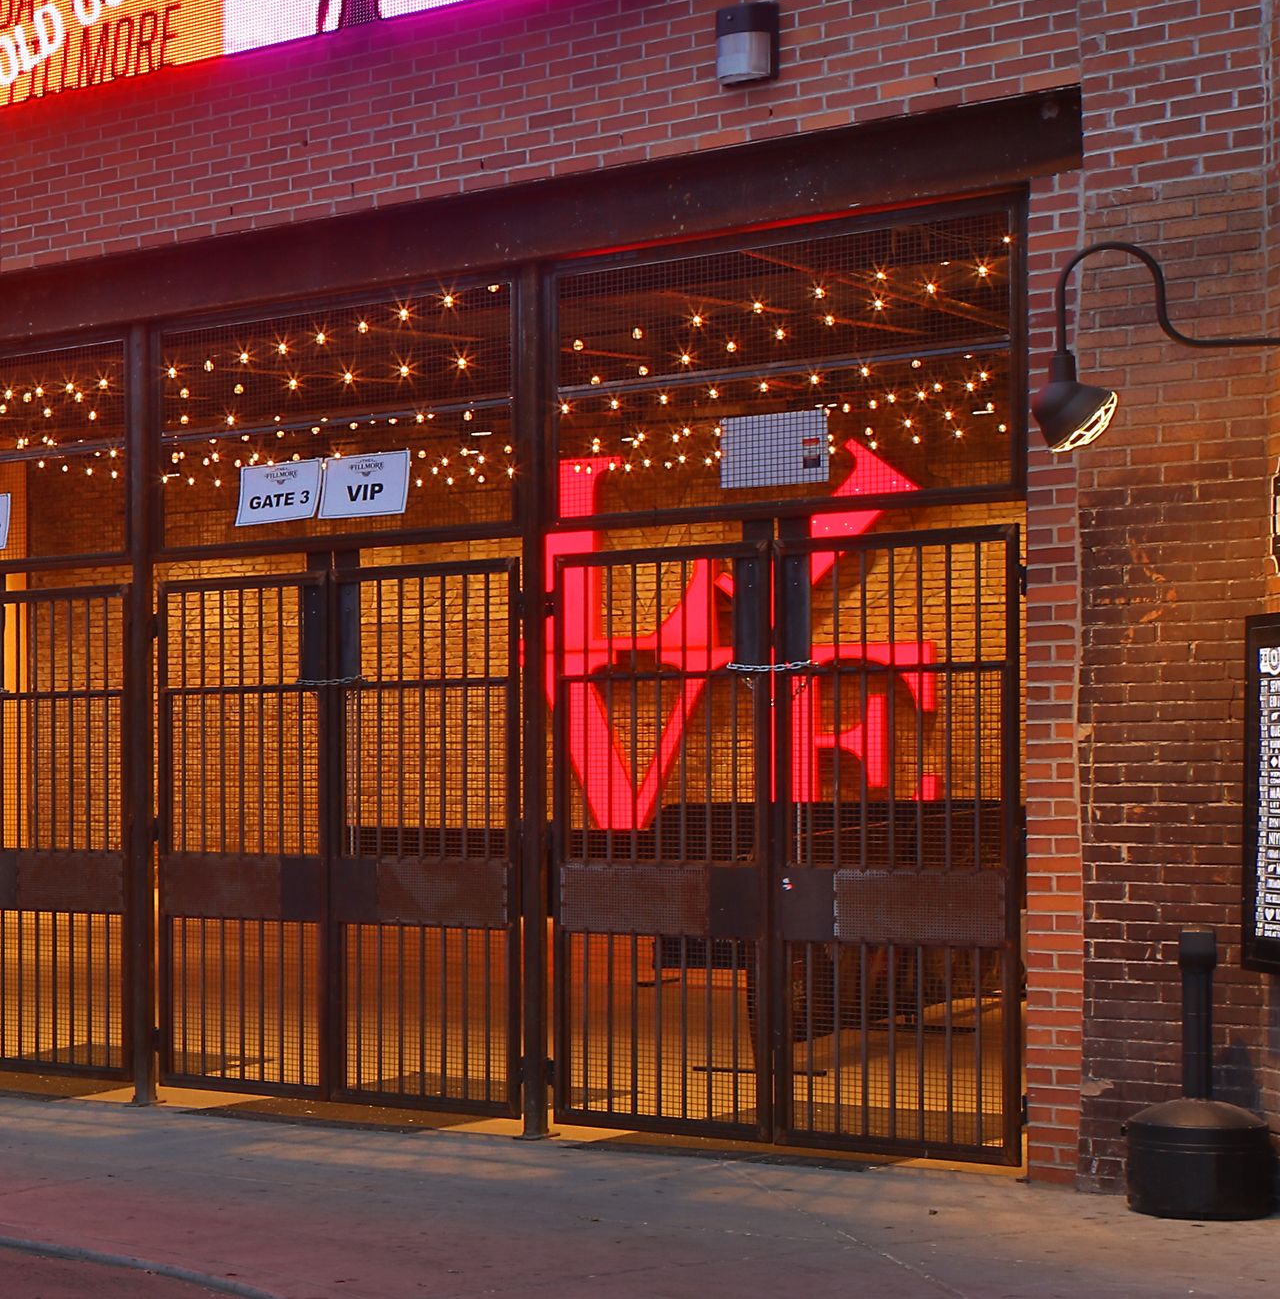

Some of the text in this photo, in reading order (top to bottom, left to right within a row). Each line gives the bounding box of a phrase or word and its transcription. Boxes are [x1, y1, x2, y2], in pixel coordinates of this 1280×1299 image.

[349, 461, 385, 472] FILLMORE
[264, 469, 299, 480] FILLMORE
[347, 482, 384, 502] VIP
[249, 490, 311, 510] GATE 3
